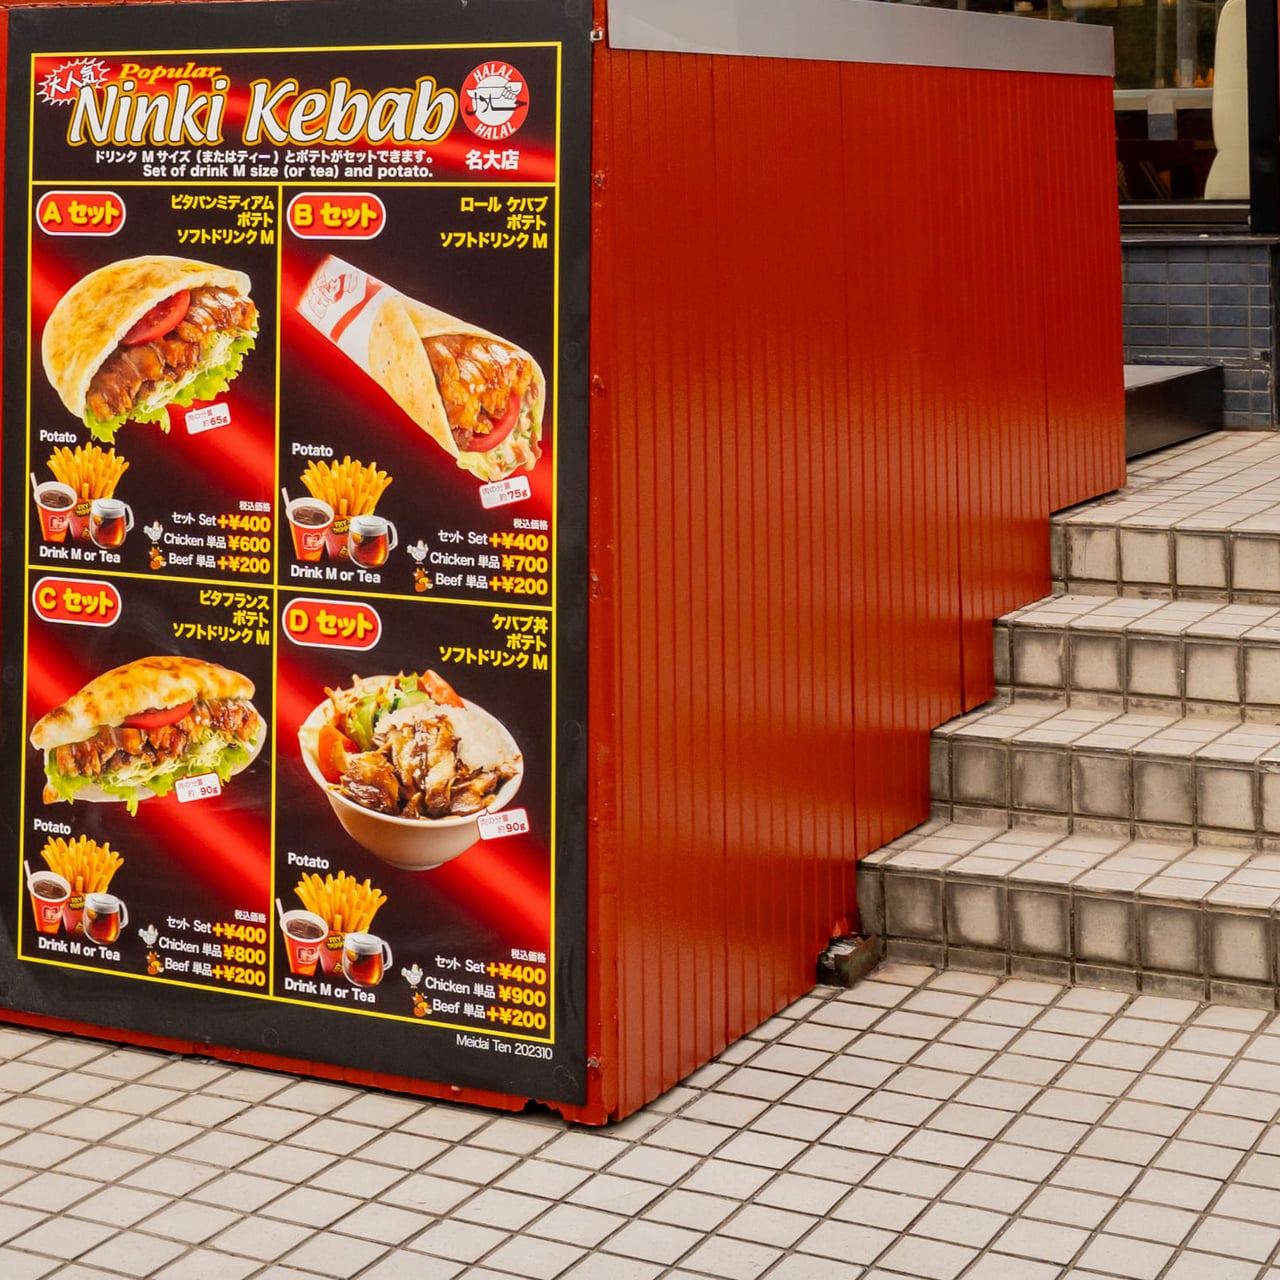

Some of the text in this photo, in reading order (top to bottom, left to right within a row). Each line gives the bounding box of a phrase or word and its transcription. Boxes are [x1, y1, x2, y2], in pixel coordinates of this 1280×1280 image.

[47, 65, 103, 98] 大人気
[119, 63, 222, 84] Popular
[473, 62, 513, 81] HALAL
[66, 76, 459, 147] Ninki Kebab
[474, 121, 516, 140] HALAL
[466, 150, 518, 170] 名大店
[143, 164, 433, 180] Set of drink M size (or tea) and potato.
[43, 201, 119, 227] A セット
[294, 202, 377, 229] B セット
[39, 430, 77, 445] Potato
[164, 533, 270, 554] Chicken ¥600
[40, 546, 120, 563] Drink M or Tea
[169, 553, 193, 566] Beef
[502, 555, 548, 574] ¥700
[39, 584, 116, 616] C セット
[290, 608, 374, 640] D セット
[492, 614, 548, 633] ケバブ丼
[223, 944, 266, 965] ¥800
[498, 985, 547, 1007] ¥900
[456, 1034, 553, 1060] Meidai Ten 202310
